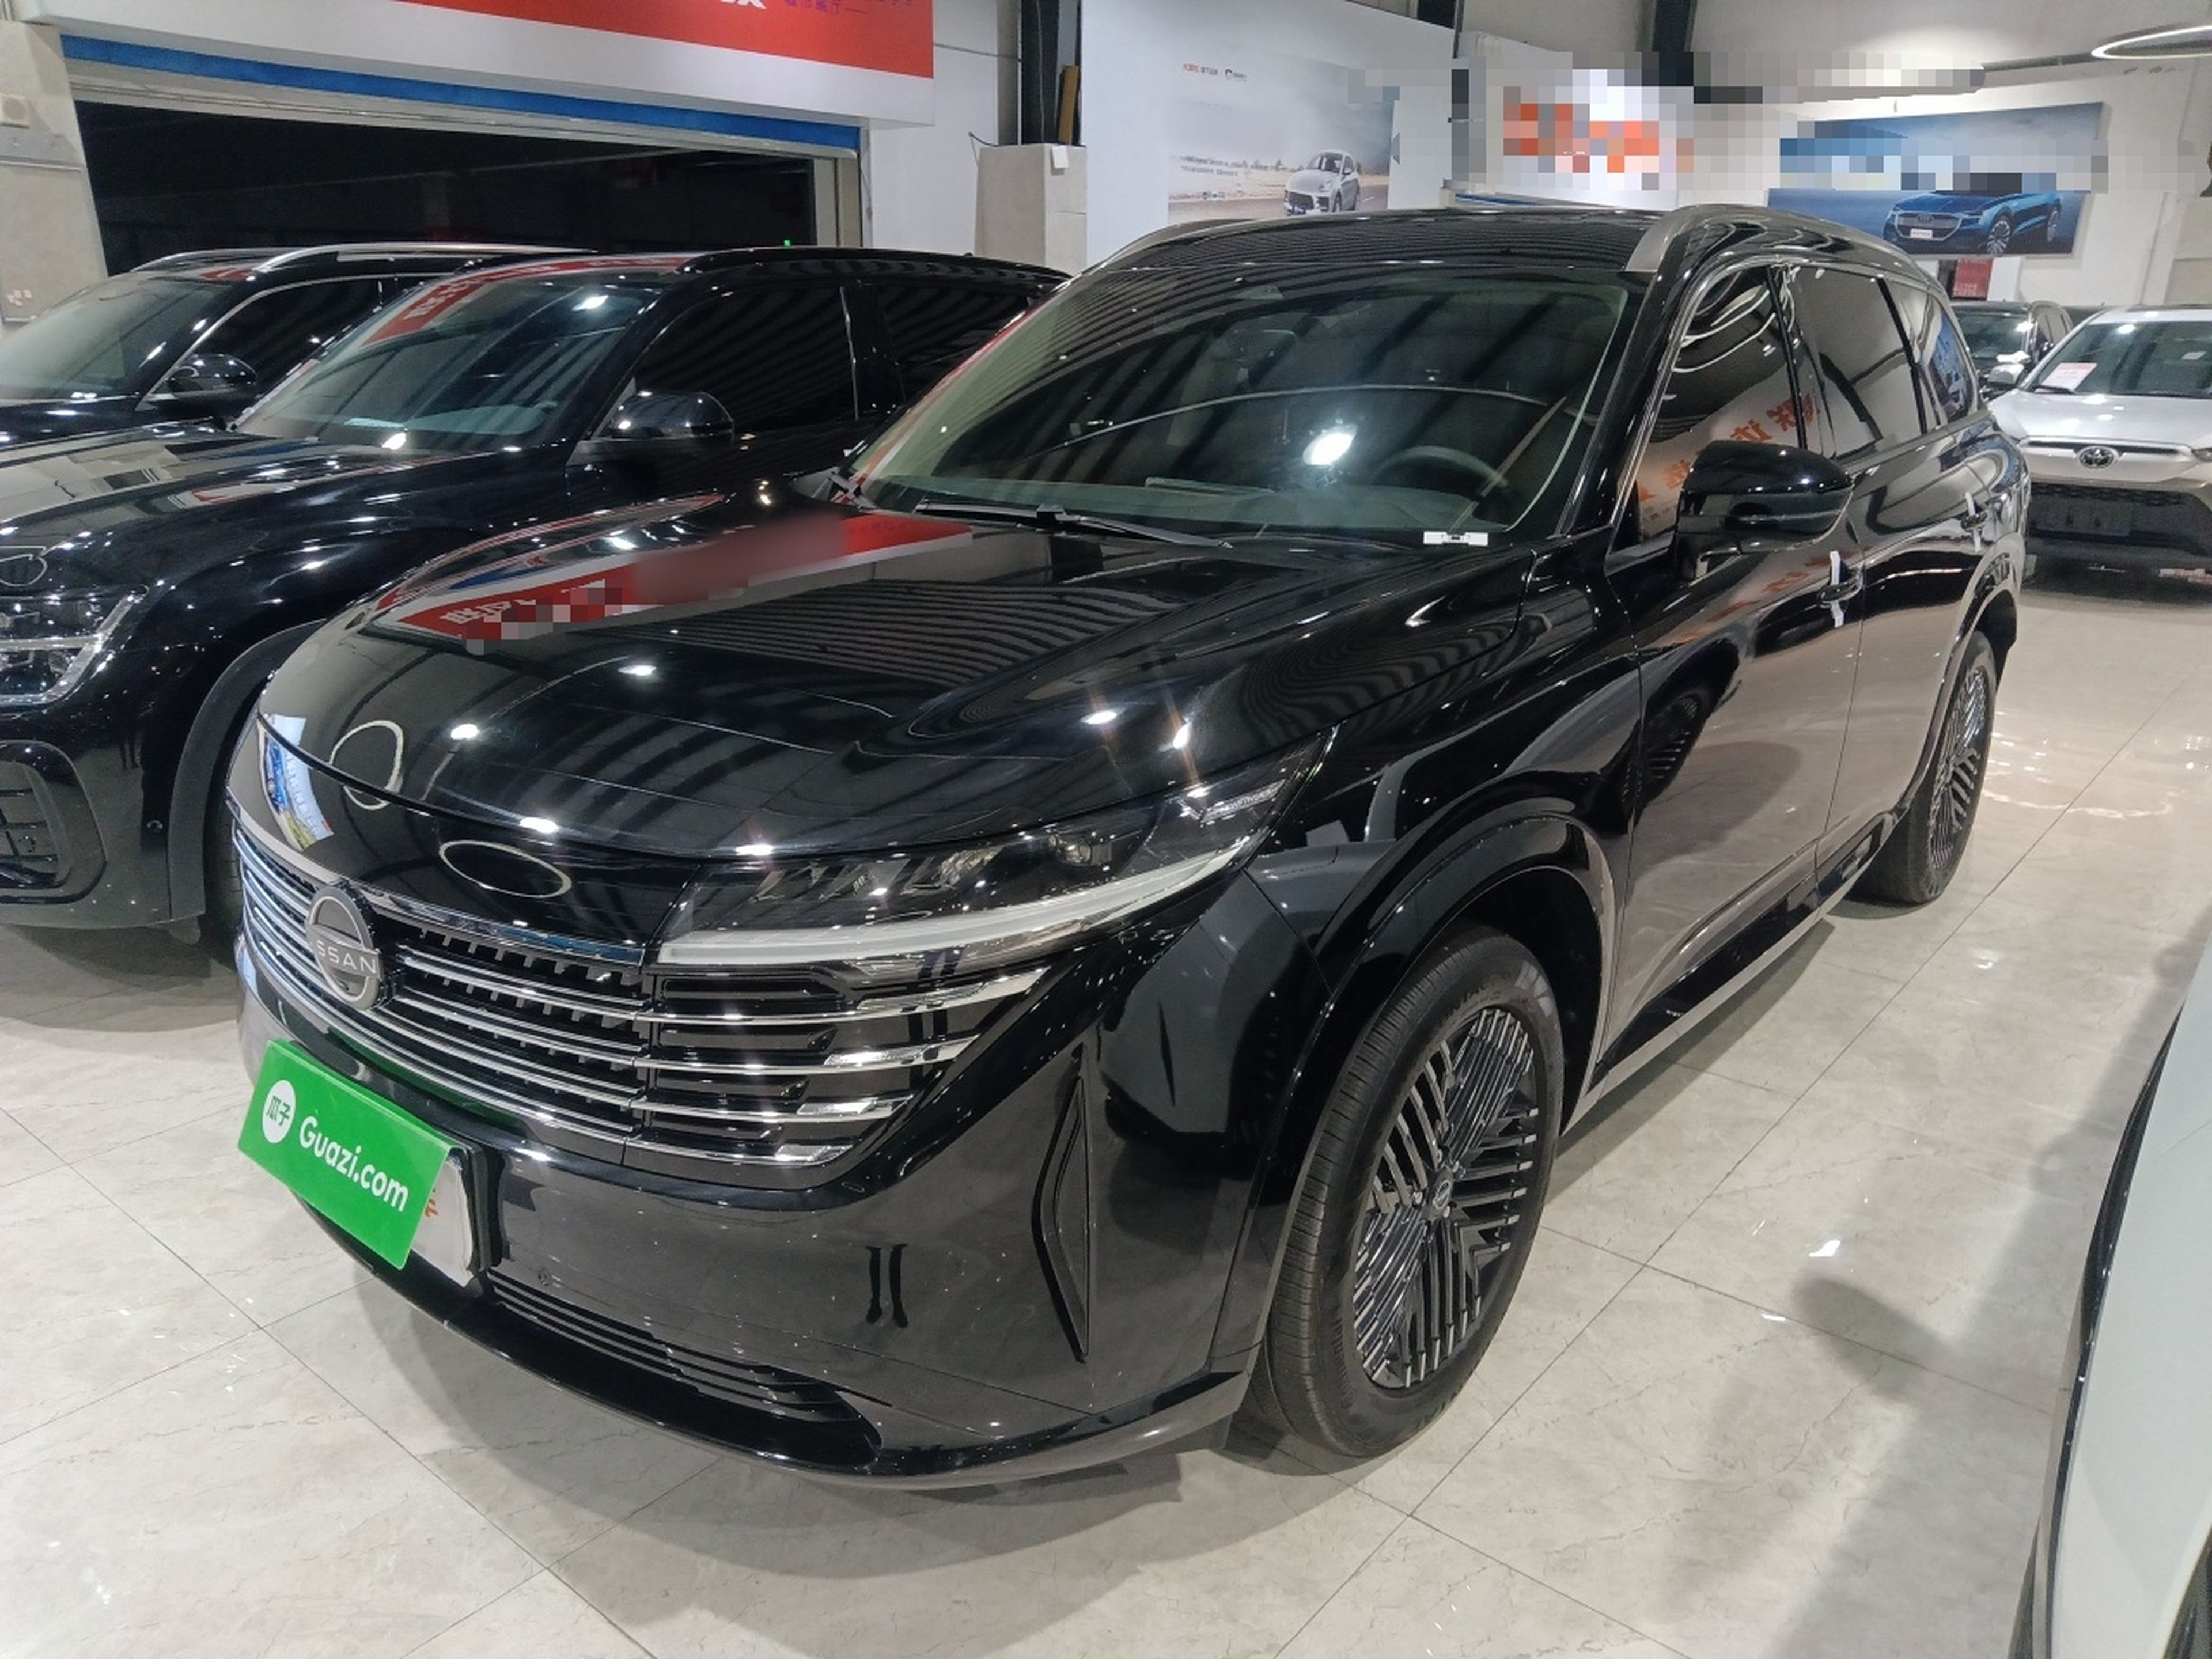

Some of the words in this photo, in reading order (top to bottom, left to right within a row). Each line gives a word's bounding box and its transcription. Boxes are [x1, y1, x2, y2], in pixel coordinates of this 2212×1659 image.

[316, 939, 377, 974] SSAN
[265, 1094, 291, 1127] 瓜子
[299, 1115, 409, 1213] Guazi.com
